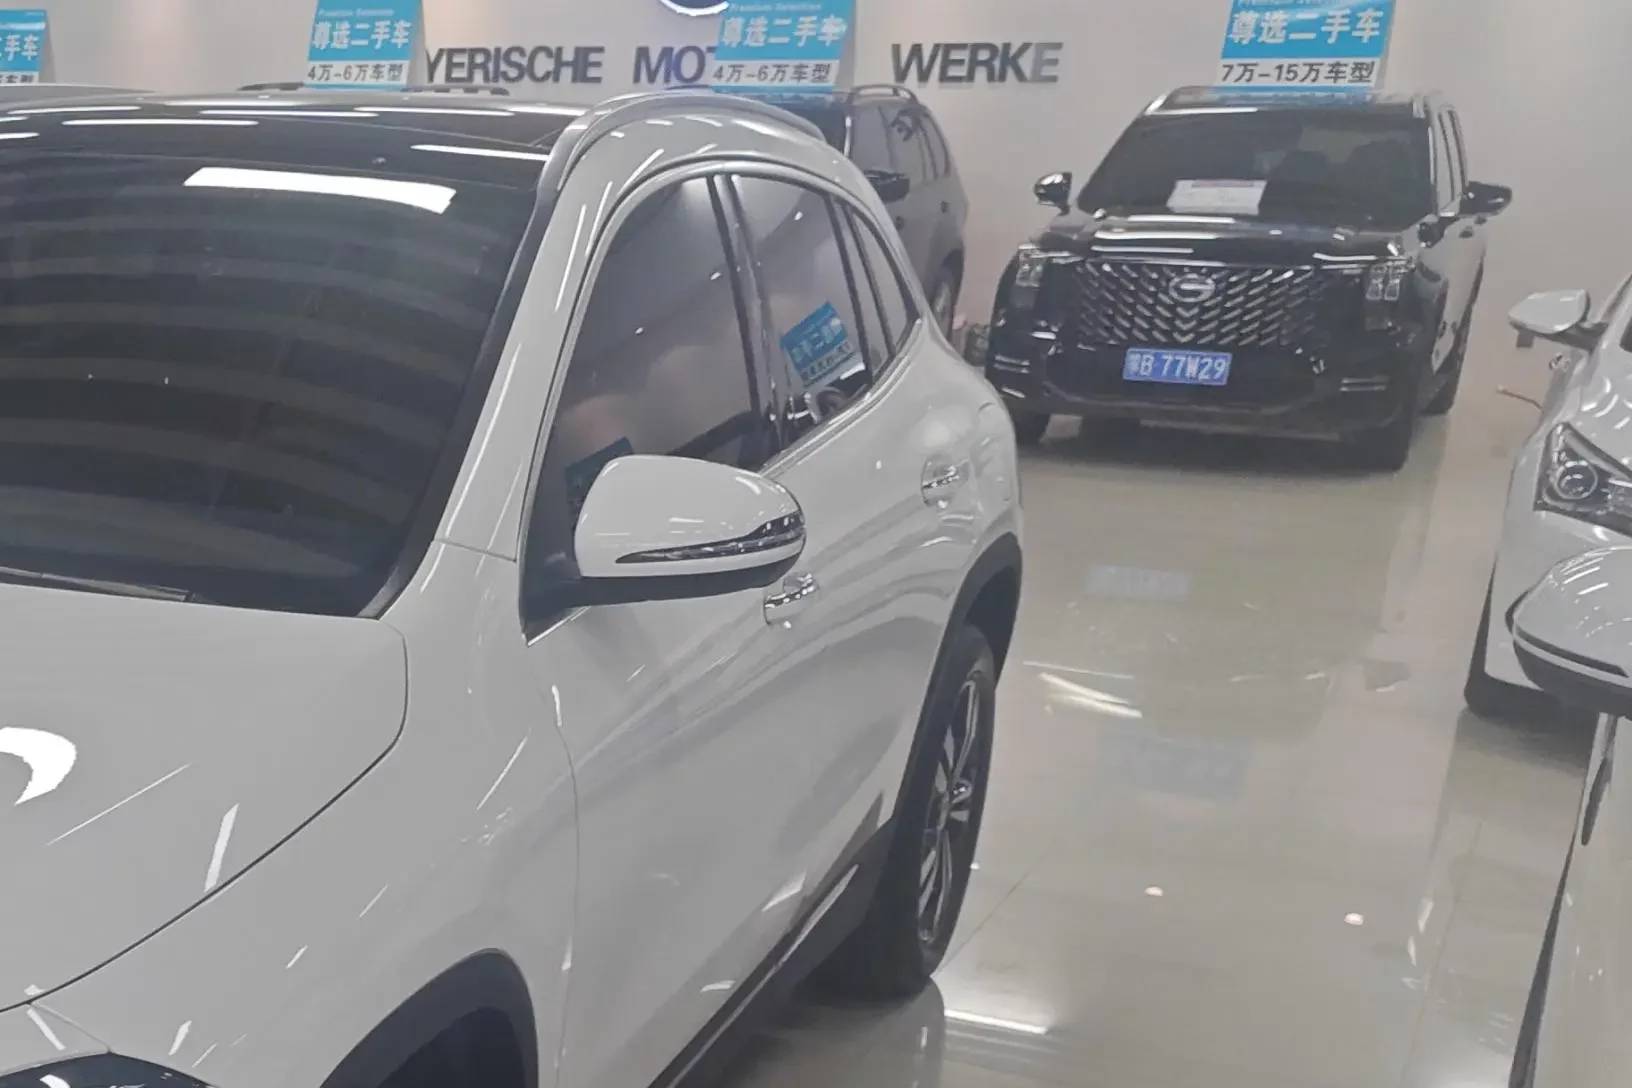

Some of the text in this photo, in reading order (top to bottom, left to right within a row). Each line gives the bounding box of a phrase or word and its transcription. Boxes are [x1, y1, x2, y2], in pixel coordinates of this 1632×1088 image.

[312, 20, 412, 50] 尊选二手车
[721, 14, 848, 47] 尊选二手车
[1228, 9, 1384, 44] 尊选二手车
[307, 64, 404, 81] 4万-6万车型
[712, 63, 831, 83] 4万-6万车型
[891, 42, 1063, 83] WERKE
[1221, 61, 1376, 83] 7万-15万车型
